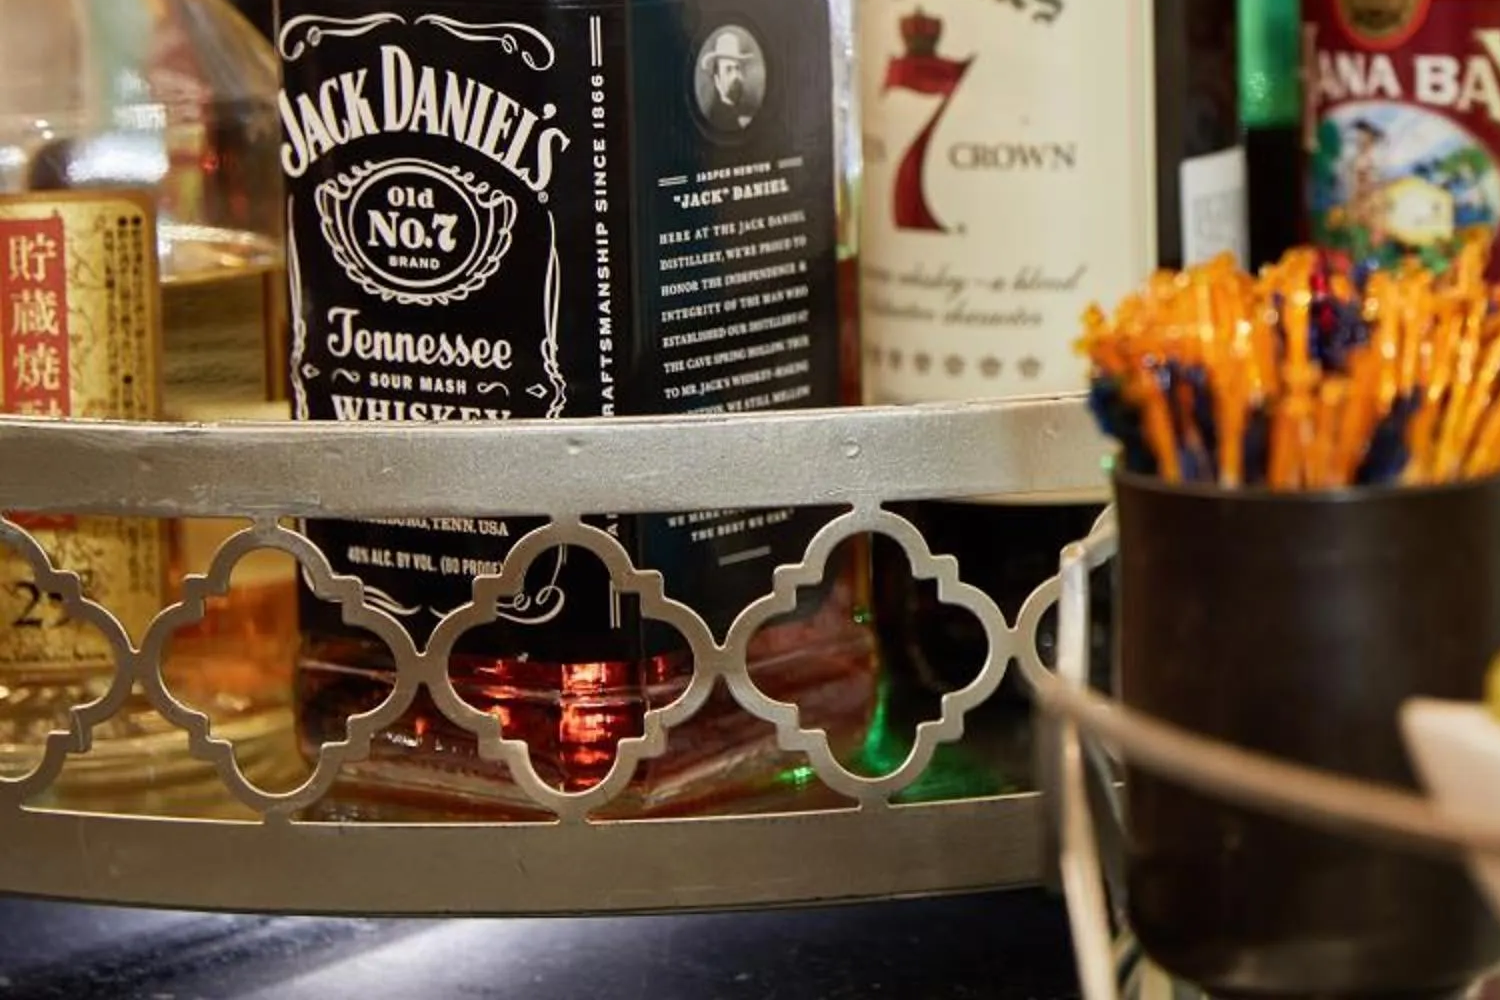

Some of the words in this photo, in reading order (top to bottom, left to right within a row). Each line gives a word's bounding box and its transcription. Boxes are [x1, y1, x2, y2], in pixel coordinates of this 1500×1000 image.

[591, 74, 605, 129] 1866
[279, 68, 380, 178] JACK
[380, 45, 571, 192] DANIEL'S
[880, 50, 977, 237] 7
[948, 142, 1077, 170] CROWN
[593, 138, 609, 212] SINCE
[387, 187, 435, 209] Old
[732, 178, 790, 201] DANIEL
[367, 210, 459, 253] No.7
[659, 229, 691, 245] HERE
[694, 226, 710, 241] AT
[713, 223, 736, 238] THE
[738, 218, 765, 235] JACK
[388, 255, 440, 271] BRAND
[702, 276, 723, 291] THE
[595, 222, 615, 418] RAFTSMANSHIP
[327, 306, 514, 370] Tennessee
[370, 371, 413, 391] SOUR
[419, 377, 467, 396] MASH
[478, 519, 509, 538] USA
[348, 546, 371, 568] 40%
[371, 548, 395, 569] ALC.
[396, 552, 411, 568] BY
[411, 554, 439, 573] VOL.
